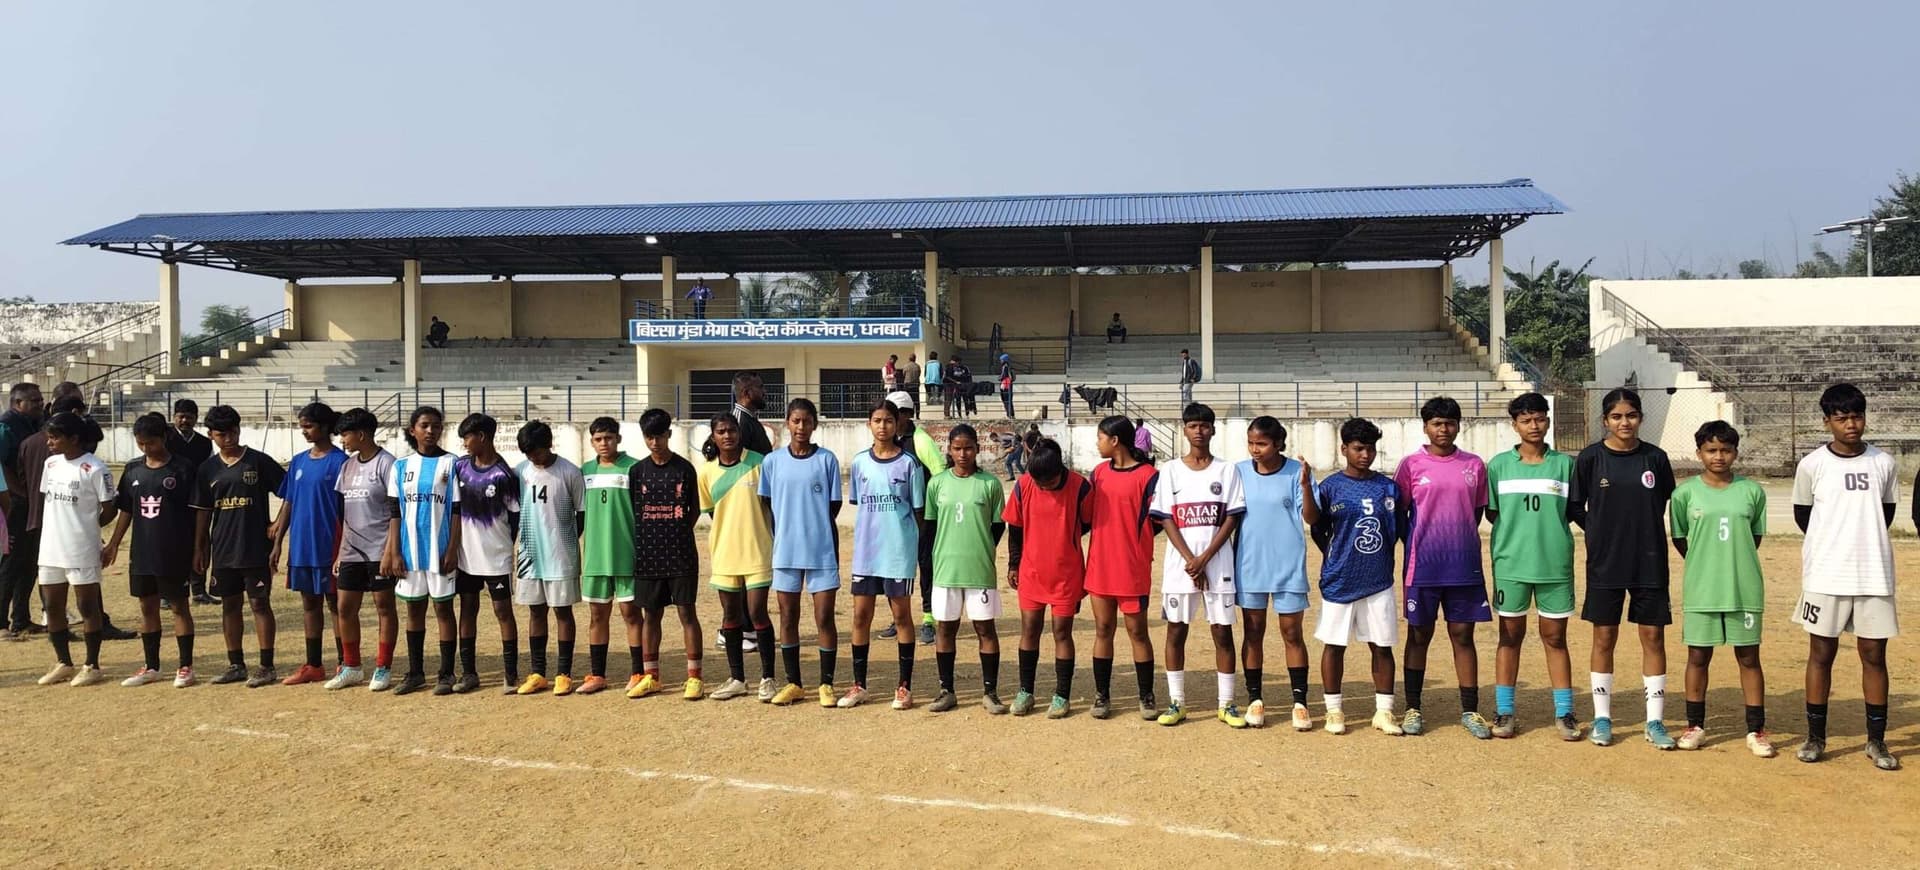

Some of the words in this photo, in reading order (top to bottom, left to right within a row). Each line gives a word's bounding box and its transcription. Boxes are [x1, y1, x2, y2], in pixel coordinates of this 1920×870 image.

[636, 322, 676, 337] बिरसा
[678, 322, 703, 340] मुंडा
[705, 322, 729, 337] मेगा
[403, 471, 414, 483] 10
[54, 492, 79, 503] blaze
[343, 489, 370, 498] COSCO
[532, 485, 547, 504] 14
[601, 489, 607, 504] 8
[860, 493, 902, 504] Emirates
[214, 496, 253, 508] akuten
[1361, 498, 1374, 515] 5
[1523, 494, 1540, 512] 10
[954, 502, 964, 523] 3
[1177, 504, 1218, 520] QATAR
[1718, 517, 1729, 541] 5
[981, 588, 989, 604] 3
[1744, 612, 1754, 630] 5
